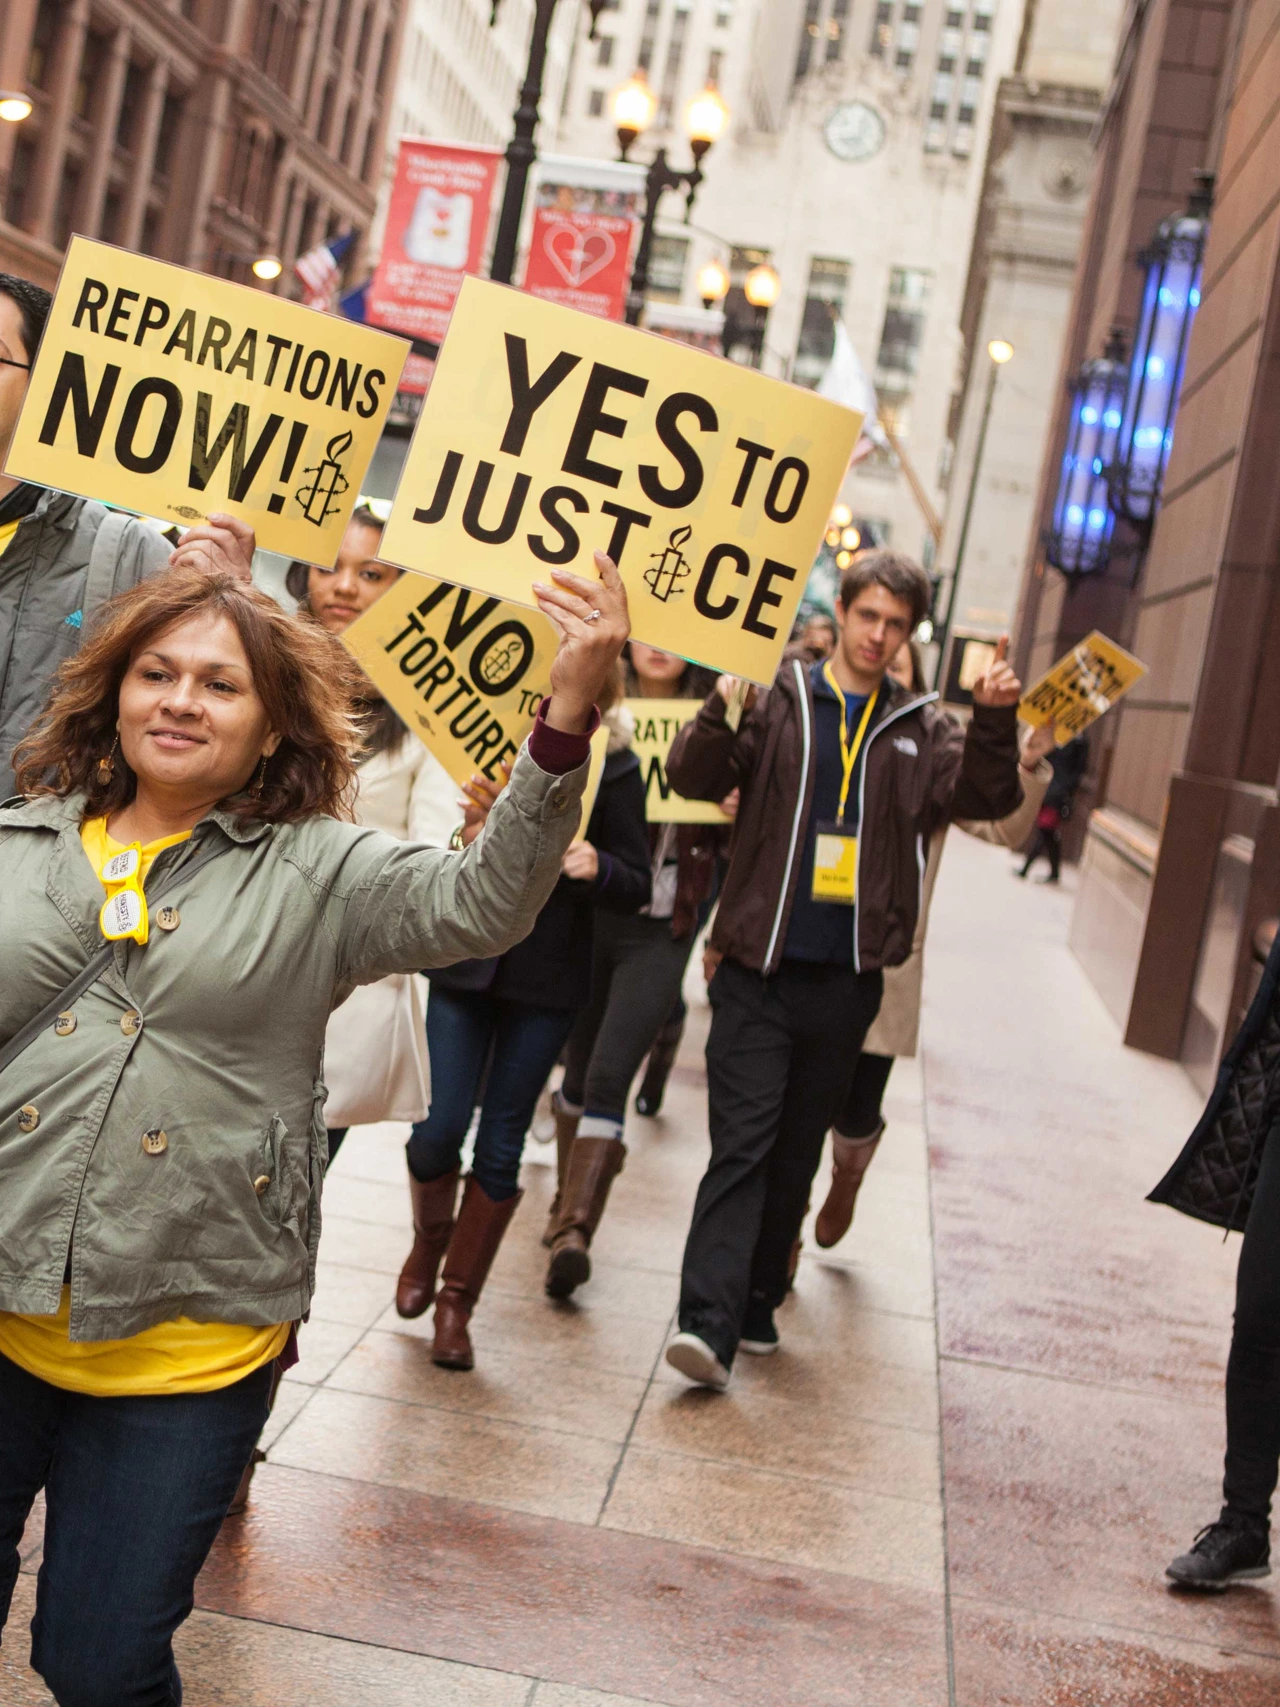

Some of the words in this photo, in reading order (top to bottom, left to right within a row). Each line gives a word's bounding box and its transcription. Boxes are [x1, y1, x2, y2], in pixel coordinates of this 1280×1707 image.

[71, 277, 386, 419] REPARATIONS
[499, 331, 719, 509] YES
[731, 436, 810, 524] TO
[37, 350, 309, 515] NOW!
[384, 612, 518, 781] TORTURE
[416, 582, 535, 697] NO
[517, 688, 543, 717] TO
